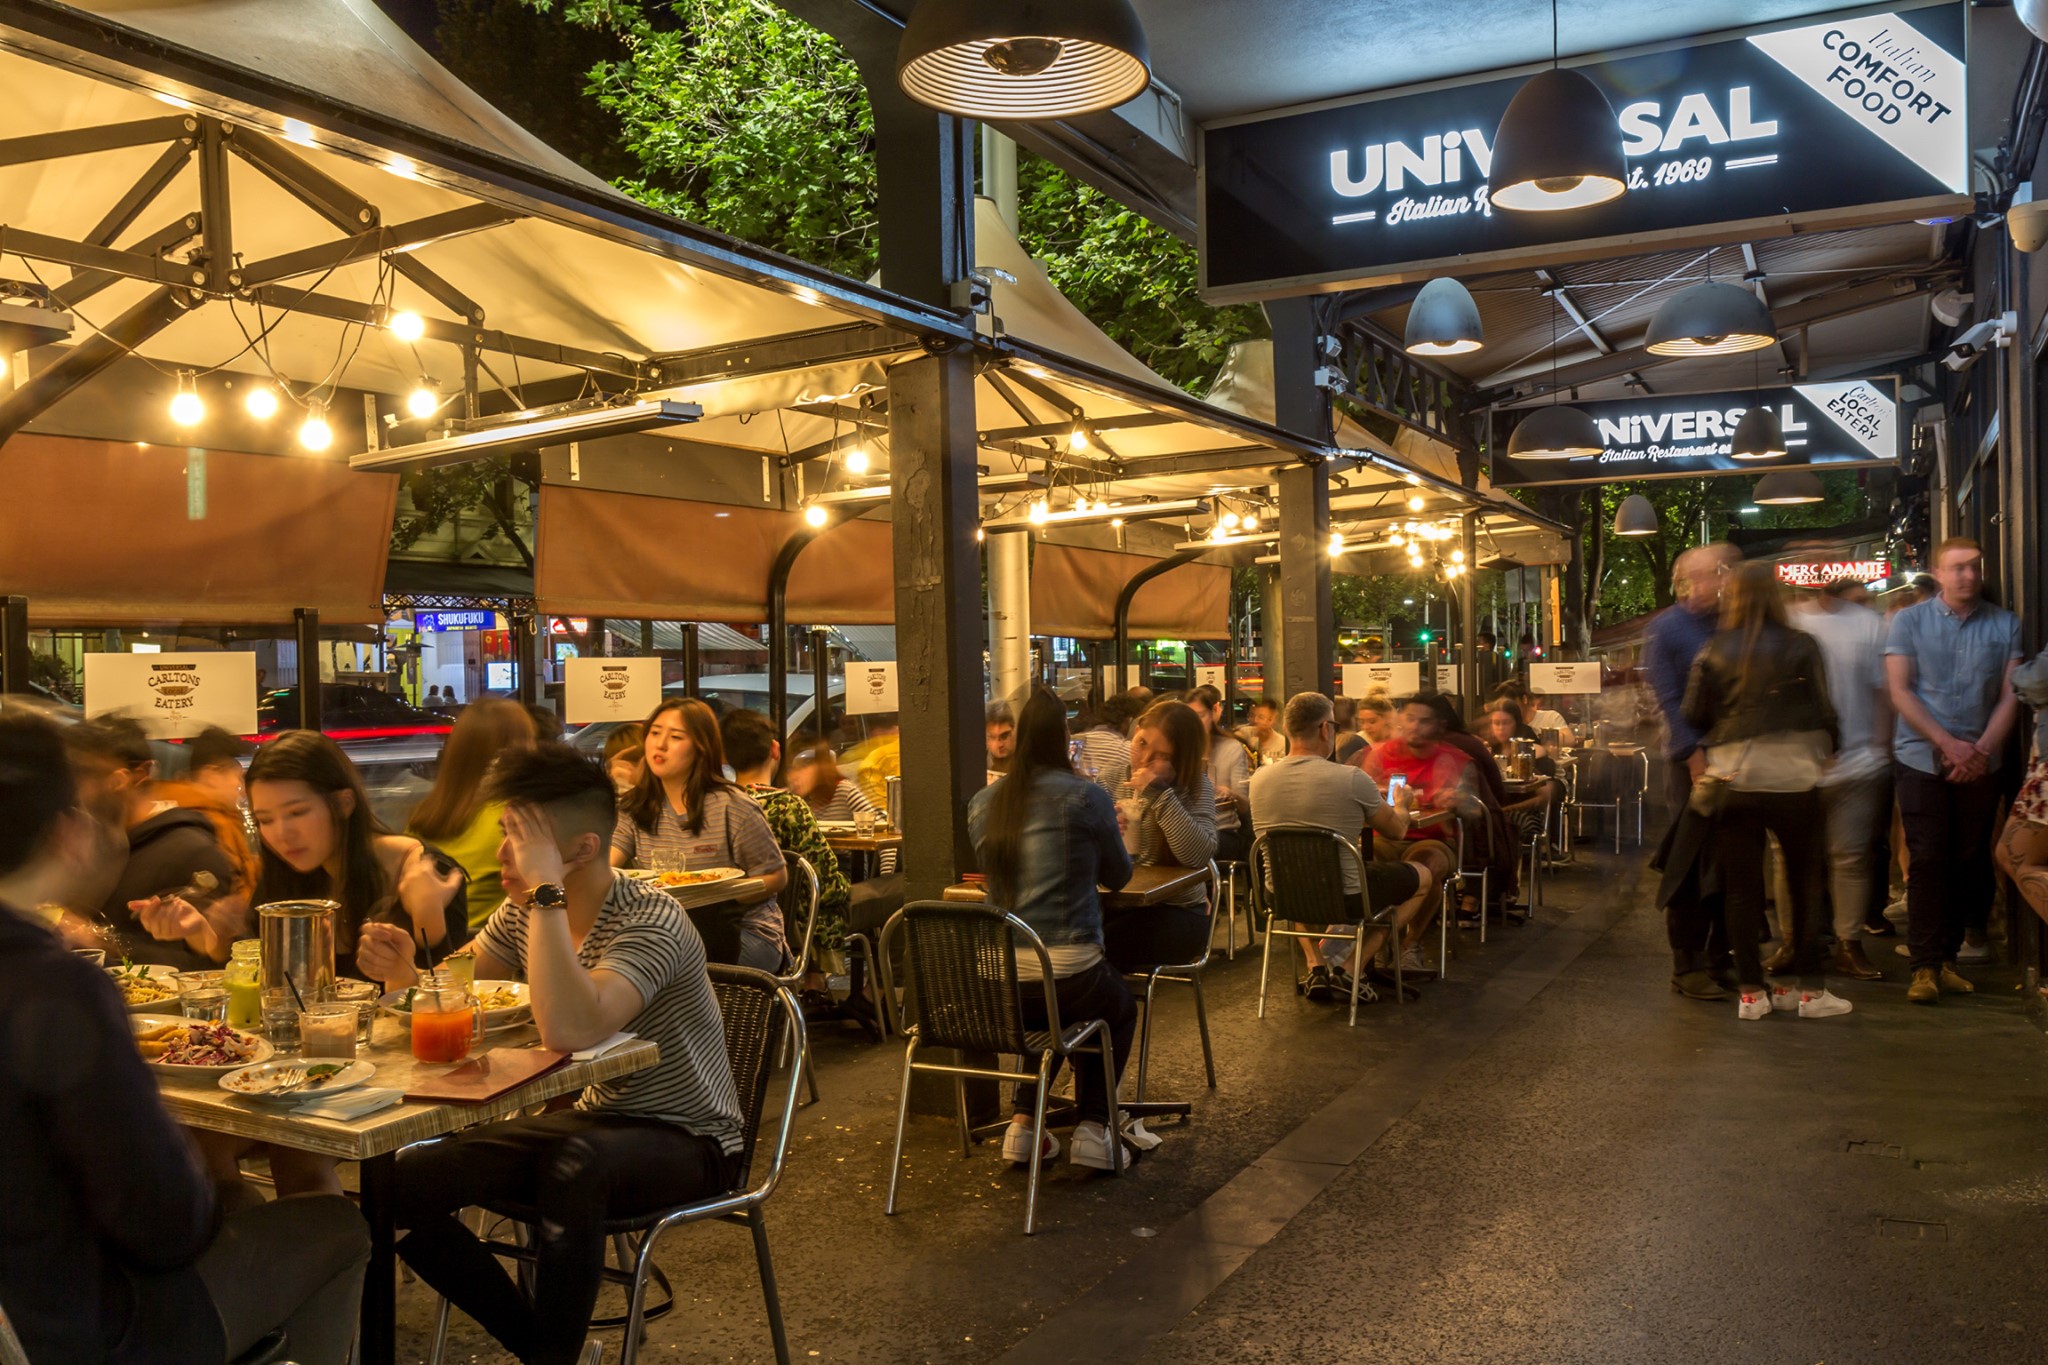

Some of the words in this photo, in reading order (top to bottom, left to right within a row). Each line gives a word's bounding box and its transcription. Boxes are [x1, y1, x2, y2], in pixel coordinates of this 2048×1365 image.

[1868, 29, 1936, 83] Italian
[1823, 30, 1952, 124] COMFORT
[1826, 65, 1901, 124] FOOD
[1386, 194, 1472, 226] Italian
[1654, 156, 1712, 186] 1969
[1827, 399, 1878, 440] EATERY
[1839, 392, 1881, 430] LOCAL
[1599, 448, 1647, 464] Italian
[1647, 442, 1718, 463] Restaurant
[438, 612, 484, 625] SHUKUFUKU
[148, 672, 201, 687] CARLTONS
[154, 696, 194, 709] EATERY
